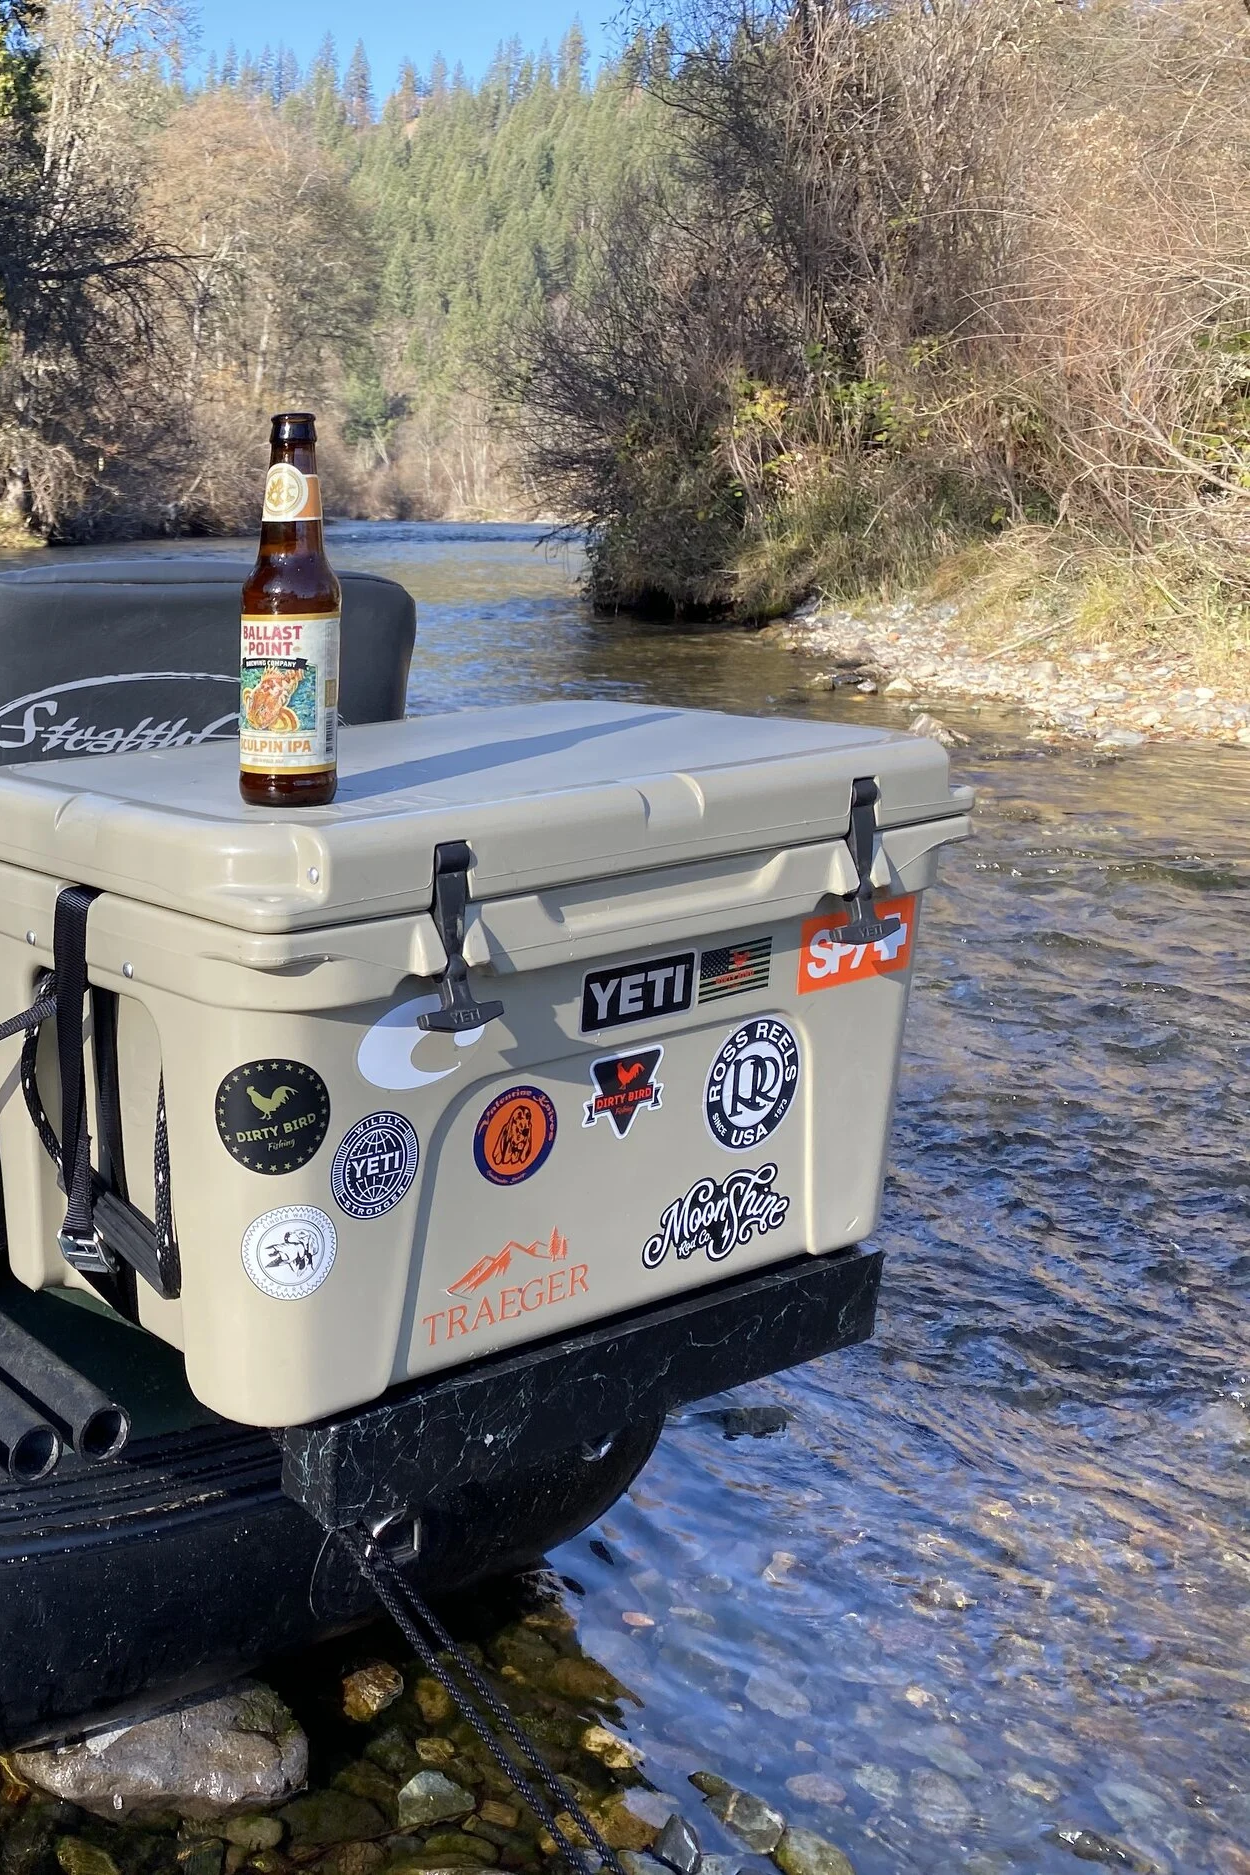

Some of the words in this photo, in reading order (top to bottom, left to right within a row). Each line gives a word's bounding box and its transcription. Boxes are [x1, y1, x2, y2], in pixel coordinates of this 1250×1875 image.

[243, 625, 303, 640] BALLAST
[248, 641, 293, 656] POINT
[266, 659, 297, 668] COMPANY
[287, 740, 312, 753] IPA
[859, 923, 884, 938] YETI
[589, 963, 686, 1021] YETI
[452, 1008, 481, 1025] YETI
[708, 1030, 749, 1103] ROSS
[755, 1022, 797, 1082] REELS
[596, 1093, 627, 1109] DIRTY
[627, 1087, 652, 1102] BIRD
[235, 1125, 279, 1143] DIRTY
[282, 1112, 317, 1134] BIRD
[354, 1116, 401, 1136] WILDLY
[712, 1112, 728, 1137] SINCE
[730, 1123, 769, 1146] USA
[773, 1098, 788, 1119] 1973
[267, 1137, 297, 1152] Fishing
[351, 1149, 402, 1179] YETI
[343, 1186, 406, 1216] STRONGER
[262, 1213, 290, 1230] CINDER
[292, 1212, 330, 1233] WATERFOWL
[678, 1234, 697, 1256] Rod
[421, 1263, 590, 1347] TRAEGER
